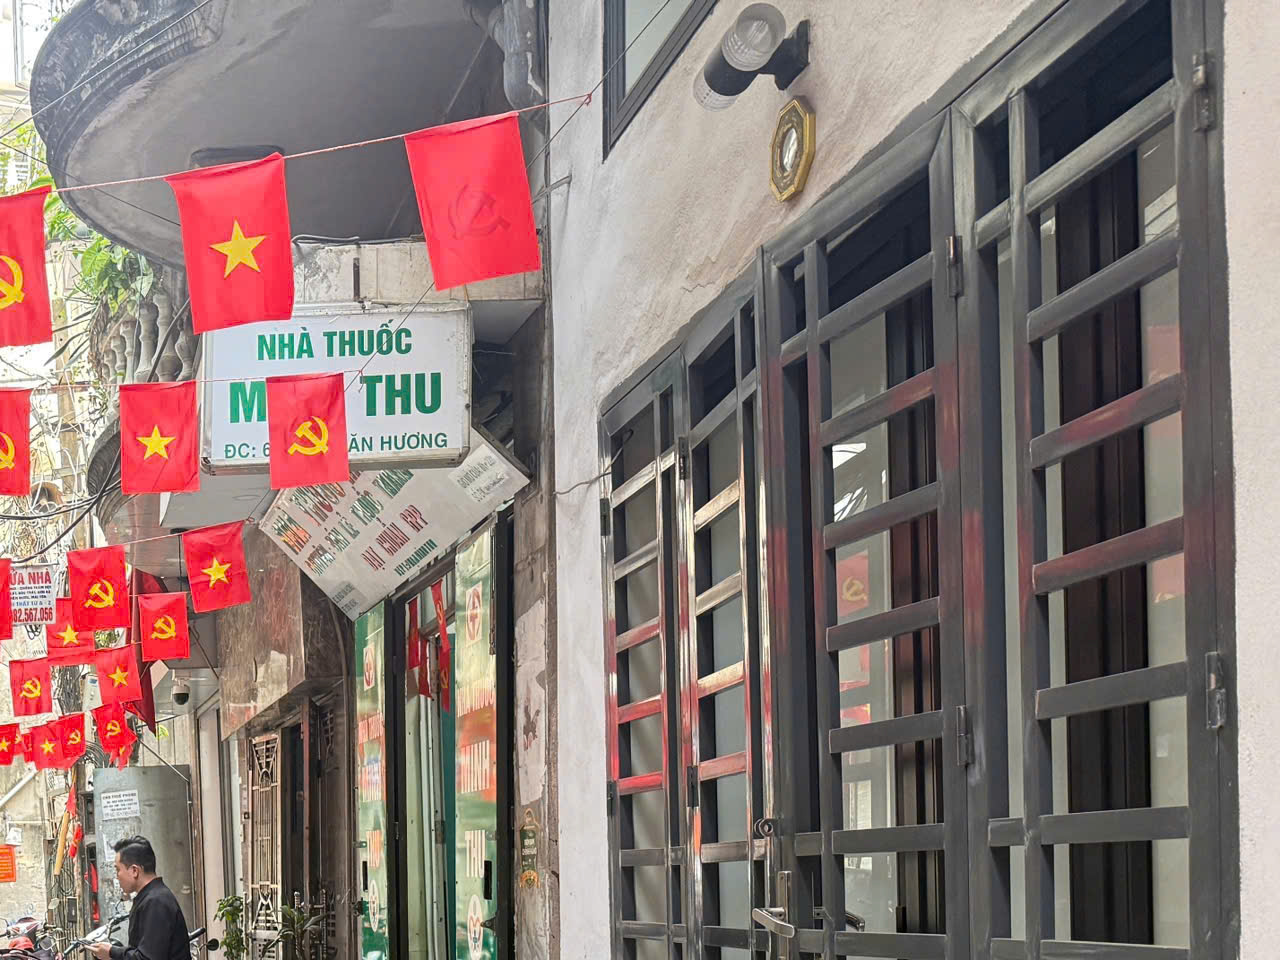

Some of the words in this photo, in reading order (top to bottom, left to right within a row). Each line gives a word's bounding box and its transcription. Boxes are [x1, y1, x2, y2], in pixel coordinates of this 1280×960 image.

[257, 326, 314, 361] NHÀ
[323, 318, 413, 358] THUỐC
[360, 372, 442, 417] THU
[224, 443, 256, 459] ĐC:
[349, 432, 373, 452] ĂN
[380, 431, 448, 451] HƯƠNG
[10, 567, 25, 586] ỬA
[28, 567, 52, 585] NHÀ
[13, 607, 53, 623] 82.567.056
[461, 740, 490, 794] MINH
[464, 829, 486, 878] THU
